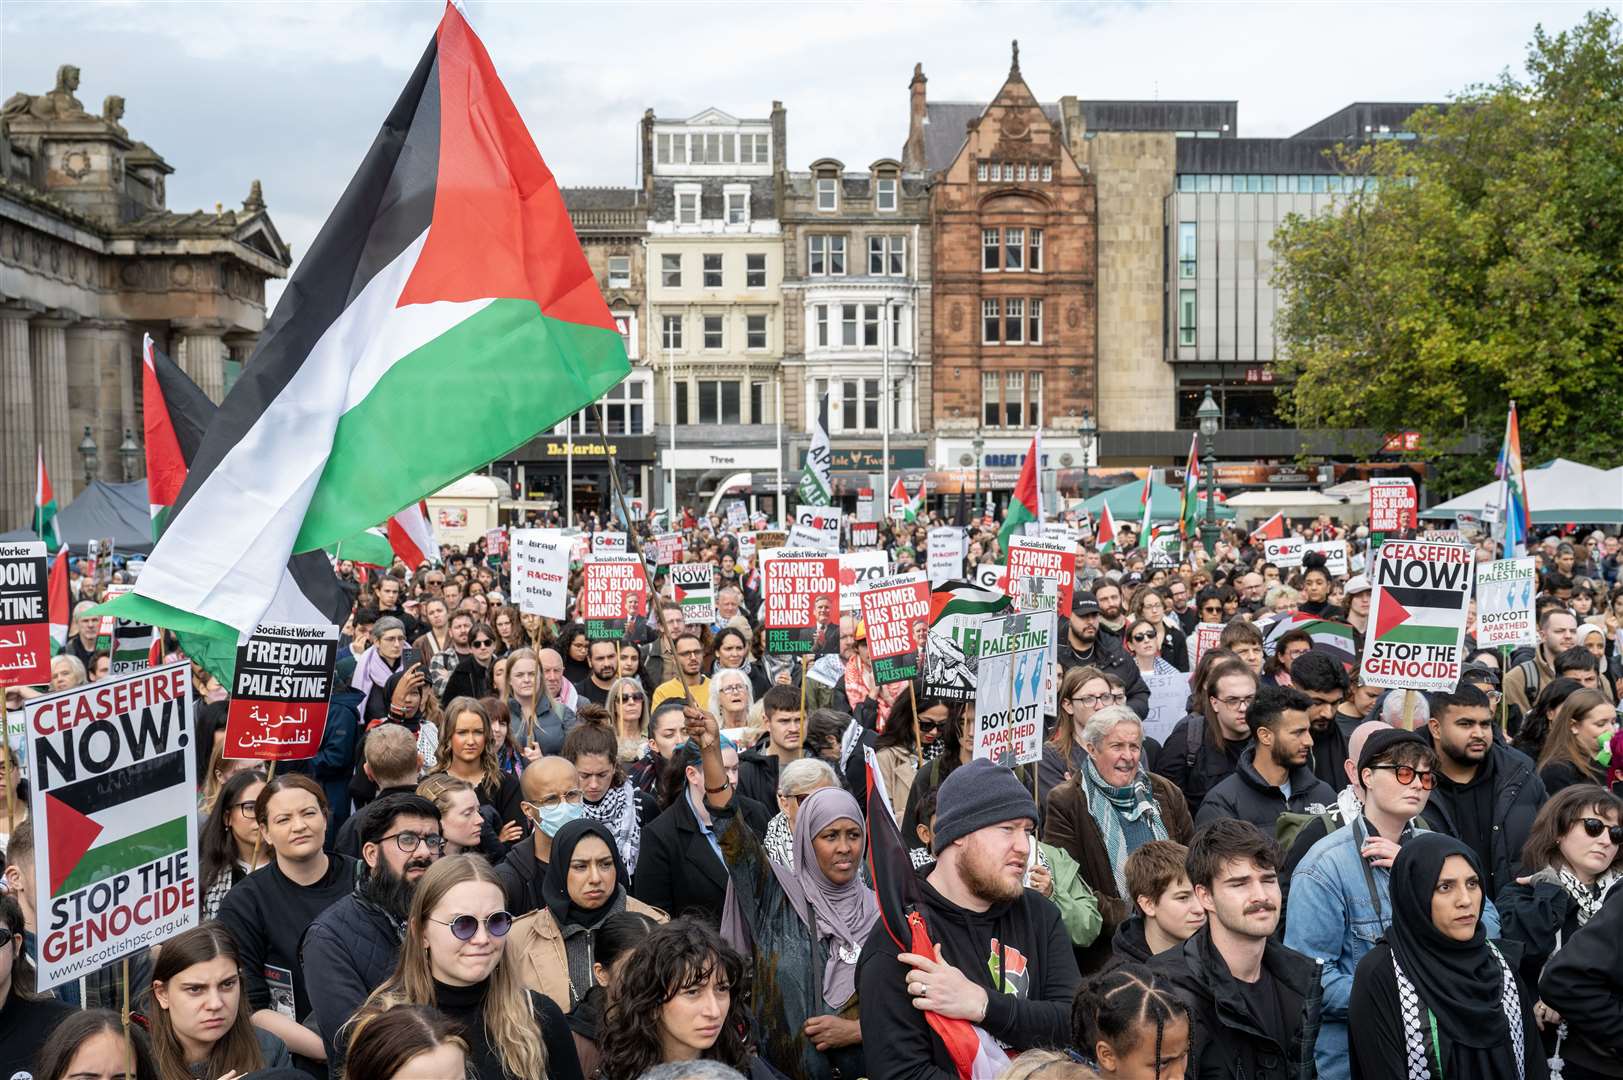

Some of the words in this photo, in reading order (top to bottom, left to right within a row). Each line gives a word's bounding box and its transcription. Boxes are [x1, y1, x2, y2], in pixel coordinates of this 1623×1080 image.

[709, 455, 735, 464] Three
[864, 455, 895, 465] Twed
[985, 454, 1018, 467] GREAT
[1373, 487, 1408, 498] STARMER
[1373, 498, 1388, 508] HAS
[1389, 498, 1415, 508] BLOOD
[1373, 508, 1383, 519] ON
[1385, 508, 1398, 519] HIS
[800, 513, 838, 530] Gza
[1373, 519, 1398, 530] HANDS
[595, 535, 625, 546] Gza
[852, 529, 878, 546] NOW
[528, 539, 557, 551] Israel
[1020, 539, 1044, 548] Socialist
[1044, 542, 1066, 551] Worker
[1268, 544, 1302, 556] Gza
[1011, 549, 1062, 569] STARMER
[1382, 543, 1471, 564] CEASEFIRE
[587, 565, 634, 578] STARMER
[672, 565, 710, 573] CEASEFIRE
[769, 562, 824, 578] STARMER
[1010, 565, 1031, 579] HAS
[1493, 560, 1517, 572] FREE
[527, 570, 564, 583] RACIST
[672, 570, 712, 583] NOW!
[1378, 558, 1470, 591] NOW!
[1479, 568, 1533, 583] PALESTINE
[587, 578, 608, 591] HAS
[610, 578, 644, 591] BLOOD
[769, 578, 792, 594] HAS
[795, 577, 836, 593] BLOOD
[869, 579, 896, 589] Socialist
[895, 576, 916, 585] Worker
[526, 586, 552, 598] state
[587, 591, 603, 604] ON
[605, 591, 622, 603] HIS
[863, 587, 917, 609] STARMER
[769, 594, 786, 609] ON
[790, 594, 810, 609] HIS
[587, 604, 622, 617] HANDS
[684, 610, 714, 618] NOCIDE
[769, 610, 809, 625] HANDS
[866, 608, 889, 625] HAS
[891, 600, 929, 620] BLOOD
[1481, 610, 1529, 624] BOYCOTT
[256, 624, 296, 637] Socialist
[296, 628, 325, 638] Worker
[588, 620, 605, 630] FREE
[869, 624, 886, 640] ON
[888, 620, 908, 637] HIS
[1483, 621, 1529, 633] APARTHEID
[588, 629, 625, 639] PALESTINE
[769, 630, 789, 641] FREE
[1489, 631, 1520, 641] ISRAEL
[769, 641, 812, 652] PALESTINE
[871, 636, 911, 657] HANDS
[982, 629, 1048, 657] PALESTINE
[246, 640, 328, 666] FREEDOM
[1372, 643, 1421, 661] STOP
[1426, 645, 1456, 662] THE
[112, 662, 129, 673] OP
[279, 665, 294, 676] for
[875, 658, 894, 672] FREE
[1365, 658, 1459, 679] GENOCIDE
[876, 666, 917, 683] PALESTINE
[237, 673, 327, 698] PALESTINE
[925, 686, 931, 696] A
[933, 687, 964, 699] ZIONIST
[966, 689, 976, 699] FR
[33, 669, 185, 735] CEASEFIRE
[249, 705, 308, 728] الحرية
[981, 703, 1038, 731] BOYCOTT
[238, 727, 312, 748] لفلسطين
[981, 723, 1035, 748] APARTHEID
[35, 695, 189, 791] NOW!
[50, 874, 130, 930] STOP
[137, 851, 188, 894] THE
[43, 878, 195, 963] GENOCIDE
[49, 913, 190, 980] www.scottishpsc.org.uk
